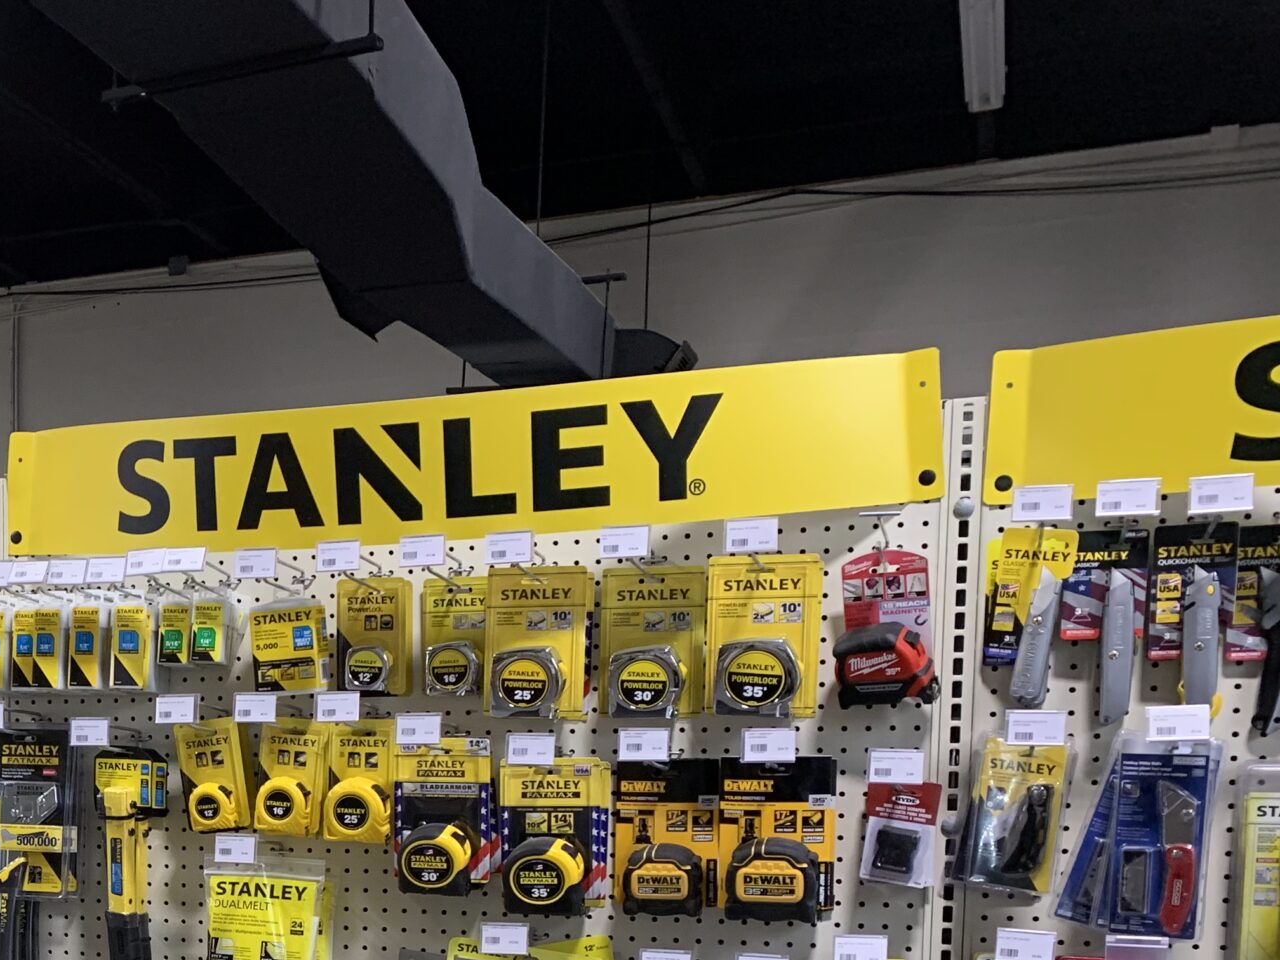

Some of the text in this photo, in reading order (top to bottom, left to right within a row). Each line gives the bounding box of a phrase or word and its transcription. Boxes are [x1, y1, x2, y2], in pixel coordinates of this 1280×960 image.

[118, 392, 724, 536] STANLEY
[1005, 549, 1070, 562] STANLEY
[1158, 543, 1234, 558] STANLEY
[723, 578, 801, 592] STANLEY
[1159, 584, 1179, 593] USA
[501, 588, 572, 601] STANLEY
[616, 588, 691, 602] STANLEY
[347, 596, 395, 605] STANLEY
[433, 597, 485, 608] STANLEY
[253, 611, 312, 626] STANLEY
[255, 642, 279, 651] 5,000
[736, 662, 775, 671] STANLEY
[849, 653, 897, 671] Milwaukee
[357, 672, 372, 682] 12'
[443, 673, 459, 683] 16'
[508, 669, 541, 677] STANLEY
[504, 680, 544, 688] POWERLOCK
[731, 674, 779, 685] POWERLOCK
[623, 682, 663, 690] POWERLOCK
[514, 690, 535, 700] 25'
[633, 690, 655, 700] 30'
[742, 686, 767, 697] 35'
[185, 736, 229, 750] STANLEY
[270, 735, 317, 748] STANLEY
[339, 738, 387, 748] STANLEY
[2, 744, 59, 755] STANLEY
[98, 762, 138, 771] STANLEY
[417, 760, 465, 769] STANLEY
[989, 758, 1056, 775] STANLEY
[522, 781, 580, 790] STANLEY
[621, 781, 666, 792] DEWALT
[724, 780, 774, 792] DEWALT
[266, 799, 291, 808] STANLEY
[895, 796, 917, 804] HYDE
[197, 804, 218, 812] STANLEY
[203, 808, 214, 817] 12'
[273, 807, 286, 815] 16'
[336, 807, 368, 815] STANLEY
[343, 814, 362, 824] 25'
[553, 814, 571, 822] 14'
[16, 834, 57, 846] 500,000
[421, 873, 439, 881] 30'
[637, 876, 682, 885] DEWALT
[744, 875, 796, 885] DEWALT
[216, 882, 307, 901] STANLEY
[531, 889, 550, 897] 35'
